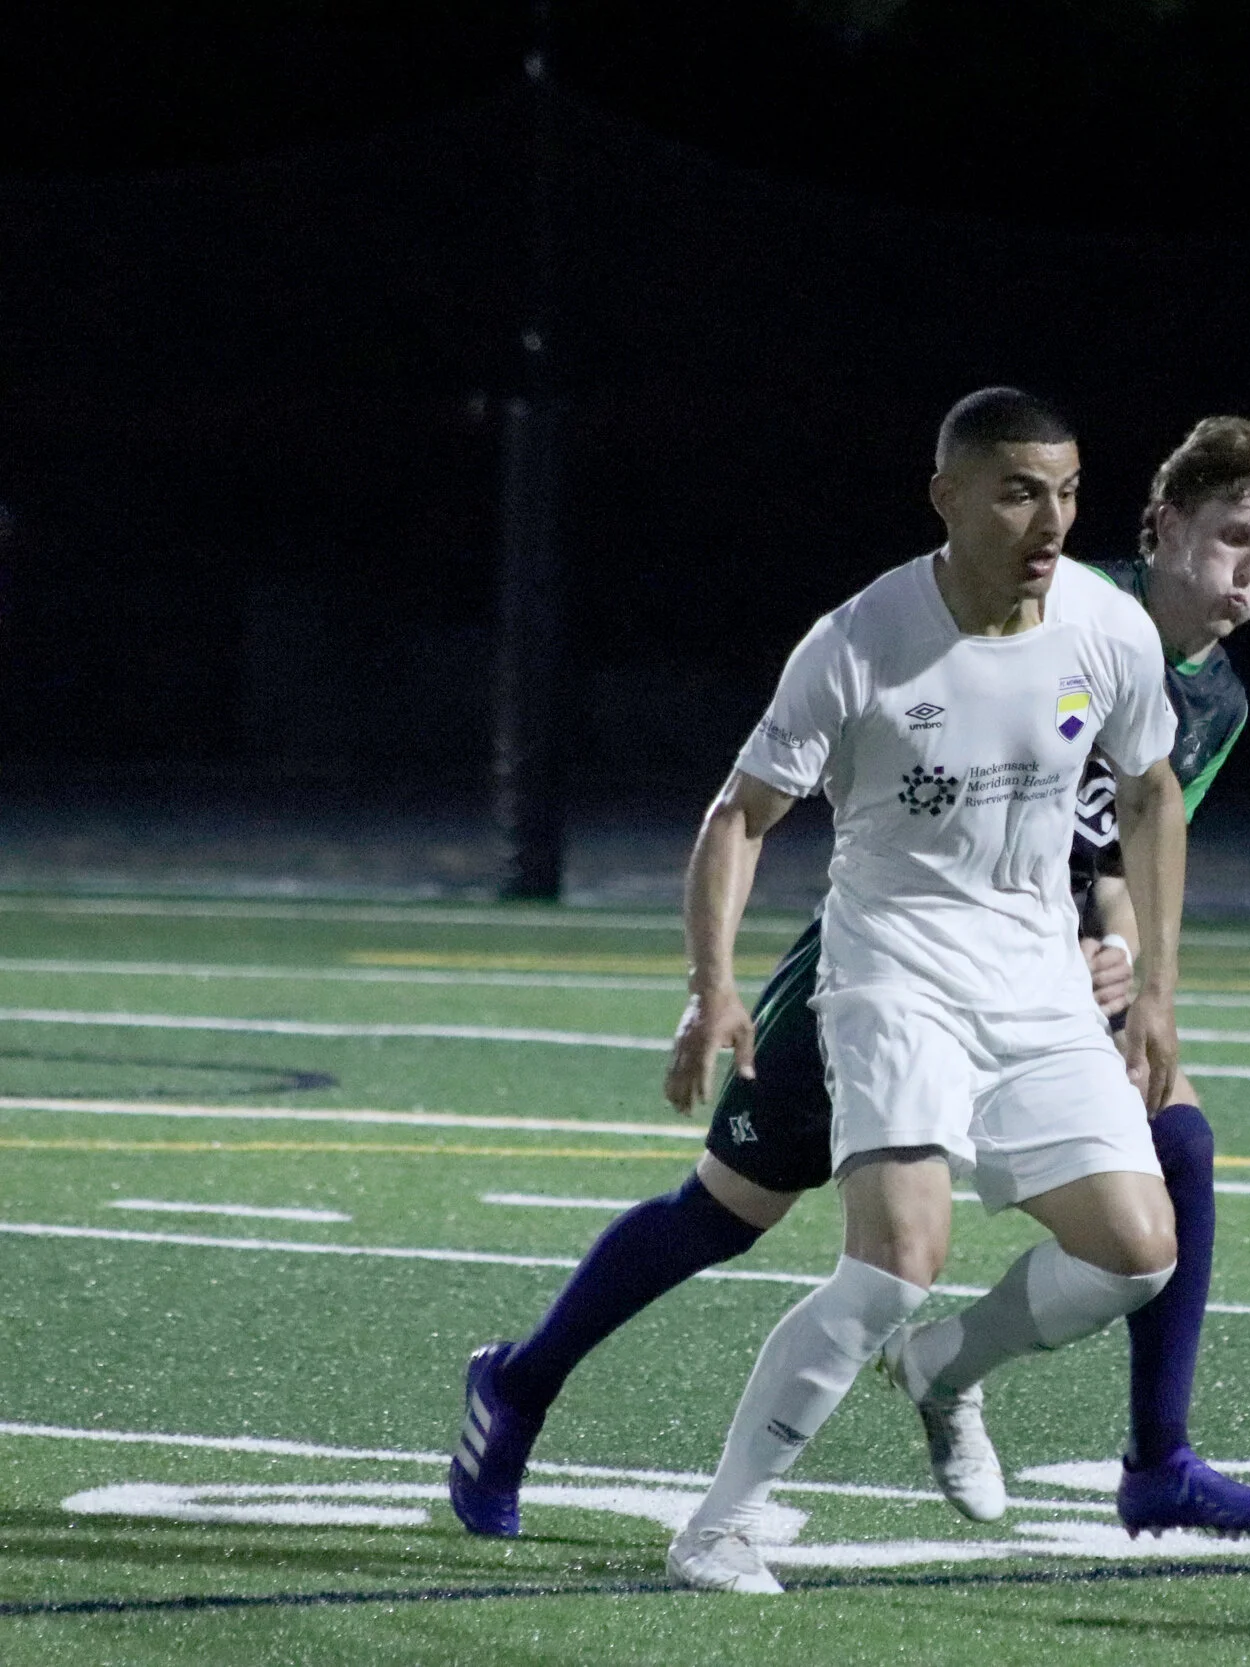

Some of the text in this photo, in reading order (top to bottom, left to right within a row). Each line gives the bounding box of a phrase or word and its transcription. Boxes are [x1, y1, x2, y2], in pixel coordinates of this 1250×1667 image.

[909, 721, 943, 731] umbro
[970, 761, 1039, 778] Hackensack
[967, 773, 1060, 792] Meridian Health
[965, 792, 1012, 807] Riverview
